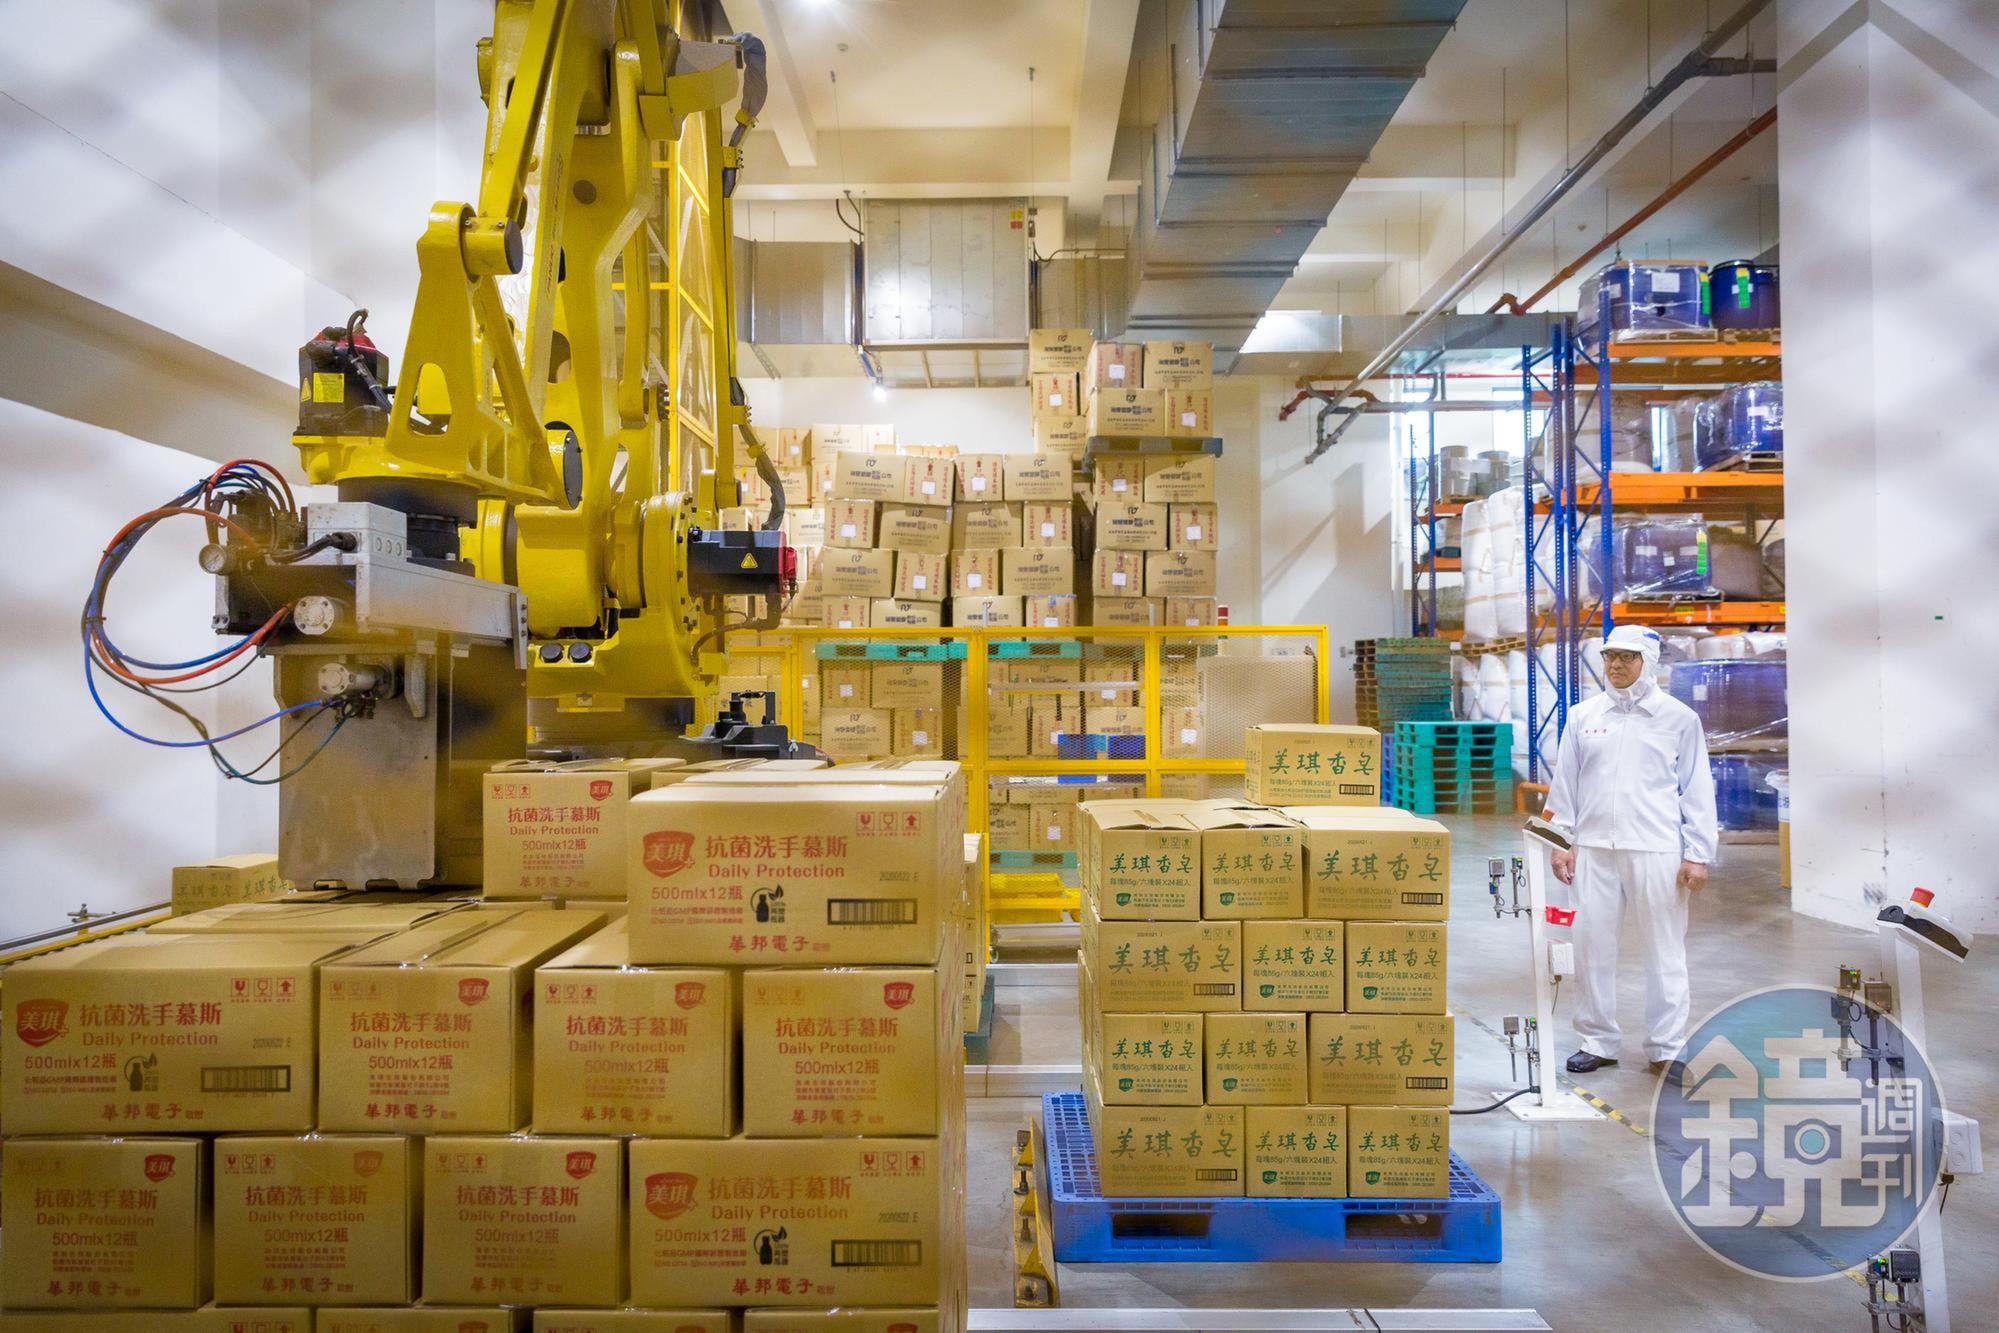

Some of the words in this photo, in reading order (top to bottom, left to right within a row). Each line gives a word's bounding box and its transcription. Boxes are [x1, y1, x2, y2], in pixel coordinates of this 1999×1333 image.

[1269, 748, 1374, 775] 美琪香皂
[508, 807, 600, 822] 抗菌洗手慕斯
[510, 826, 537, 835] Daily
[541, 825, 598, 835] Protection
[705, 835, 848, 859] 抗菌洗手慕斯
[709, 864, 750, 879] Daily
[757, 864, 844, 877] Protection
[1110, 853, 1193, 874] 美琪香皂
[1213, 852, 1295, 873] 美琪香皂
[1317, 849, 1442, 881] 美琪香皂
[729, 935, 808, 952] 華邦電子
[1109, 943, 1234, 974] 美琪香皂
[1253, 944, 1336, 965] 美琪香皂
[1356, 946, 1440, 967] 美琪香皂
[79, 1002, 222, 1026] 抗菌洗手慕斯
[351, 1012, 473, 1033] 抗菌洗手慕斯
[566, 1015, 688, 1037] 抗菌洗手慕斯
[776, 1017, 898, 1037] 抗菌洗手慕斯
[83, 1032, 124, 1047] Daily
[131, 1032, 218, 1046] Protection
[353, 1037, 389, 1050] Daily
[394, 1037, 470, 1049] Protection
[569, 1040, 602, 1053] Daily
[611, 1040, 686, 1053] Protection
[779, 1042, 814, 1054] Daily
[820, 1042, 896, 1054] Protection
[1112, 1038, 1195, 1059] 美琪香皂
[1216, 1038, 1299, 1059] 美琪香皂
[1321, 1035, 1447, 1067] 美琪香皂
[103, 1104, 181, 1120] 華邦電子
[365, 1103, 438, 1119] 華邦電子
[1111, 1128, 1237, 1160] 美琪香皂
[1256, 1130, 1339, 1151] 美琪香皂
[1359, 1131, 1443, 1152] 美琪香皂
[246, 1186, 367, 1206] 抗菌洗手慕斯
[456, 1186, 579, 1207] 抗菌洗手慕斯
[709, 1176, 851, 1200] 抗菌洗手慕斯
[35, 1189, 158, 1209] 抗菌洗手慕斯
[37, 1213, 71, 1225] Daily
[79, 1213, 154, 1226] Protection
[249, 1211, 284, 1222] Daily
[290, 1211, 364, 1222] Protection
[459, 1210, 494, 1223] Daily
[500, 1210, 576, 1223] Protection
[712, 1205, 752, 1221] Daily
[760, 1205, 848, 1219] Protection
[732, 1278, 813, 1296] 華邦電子
